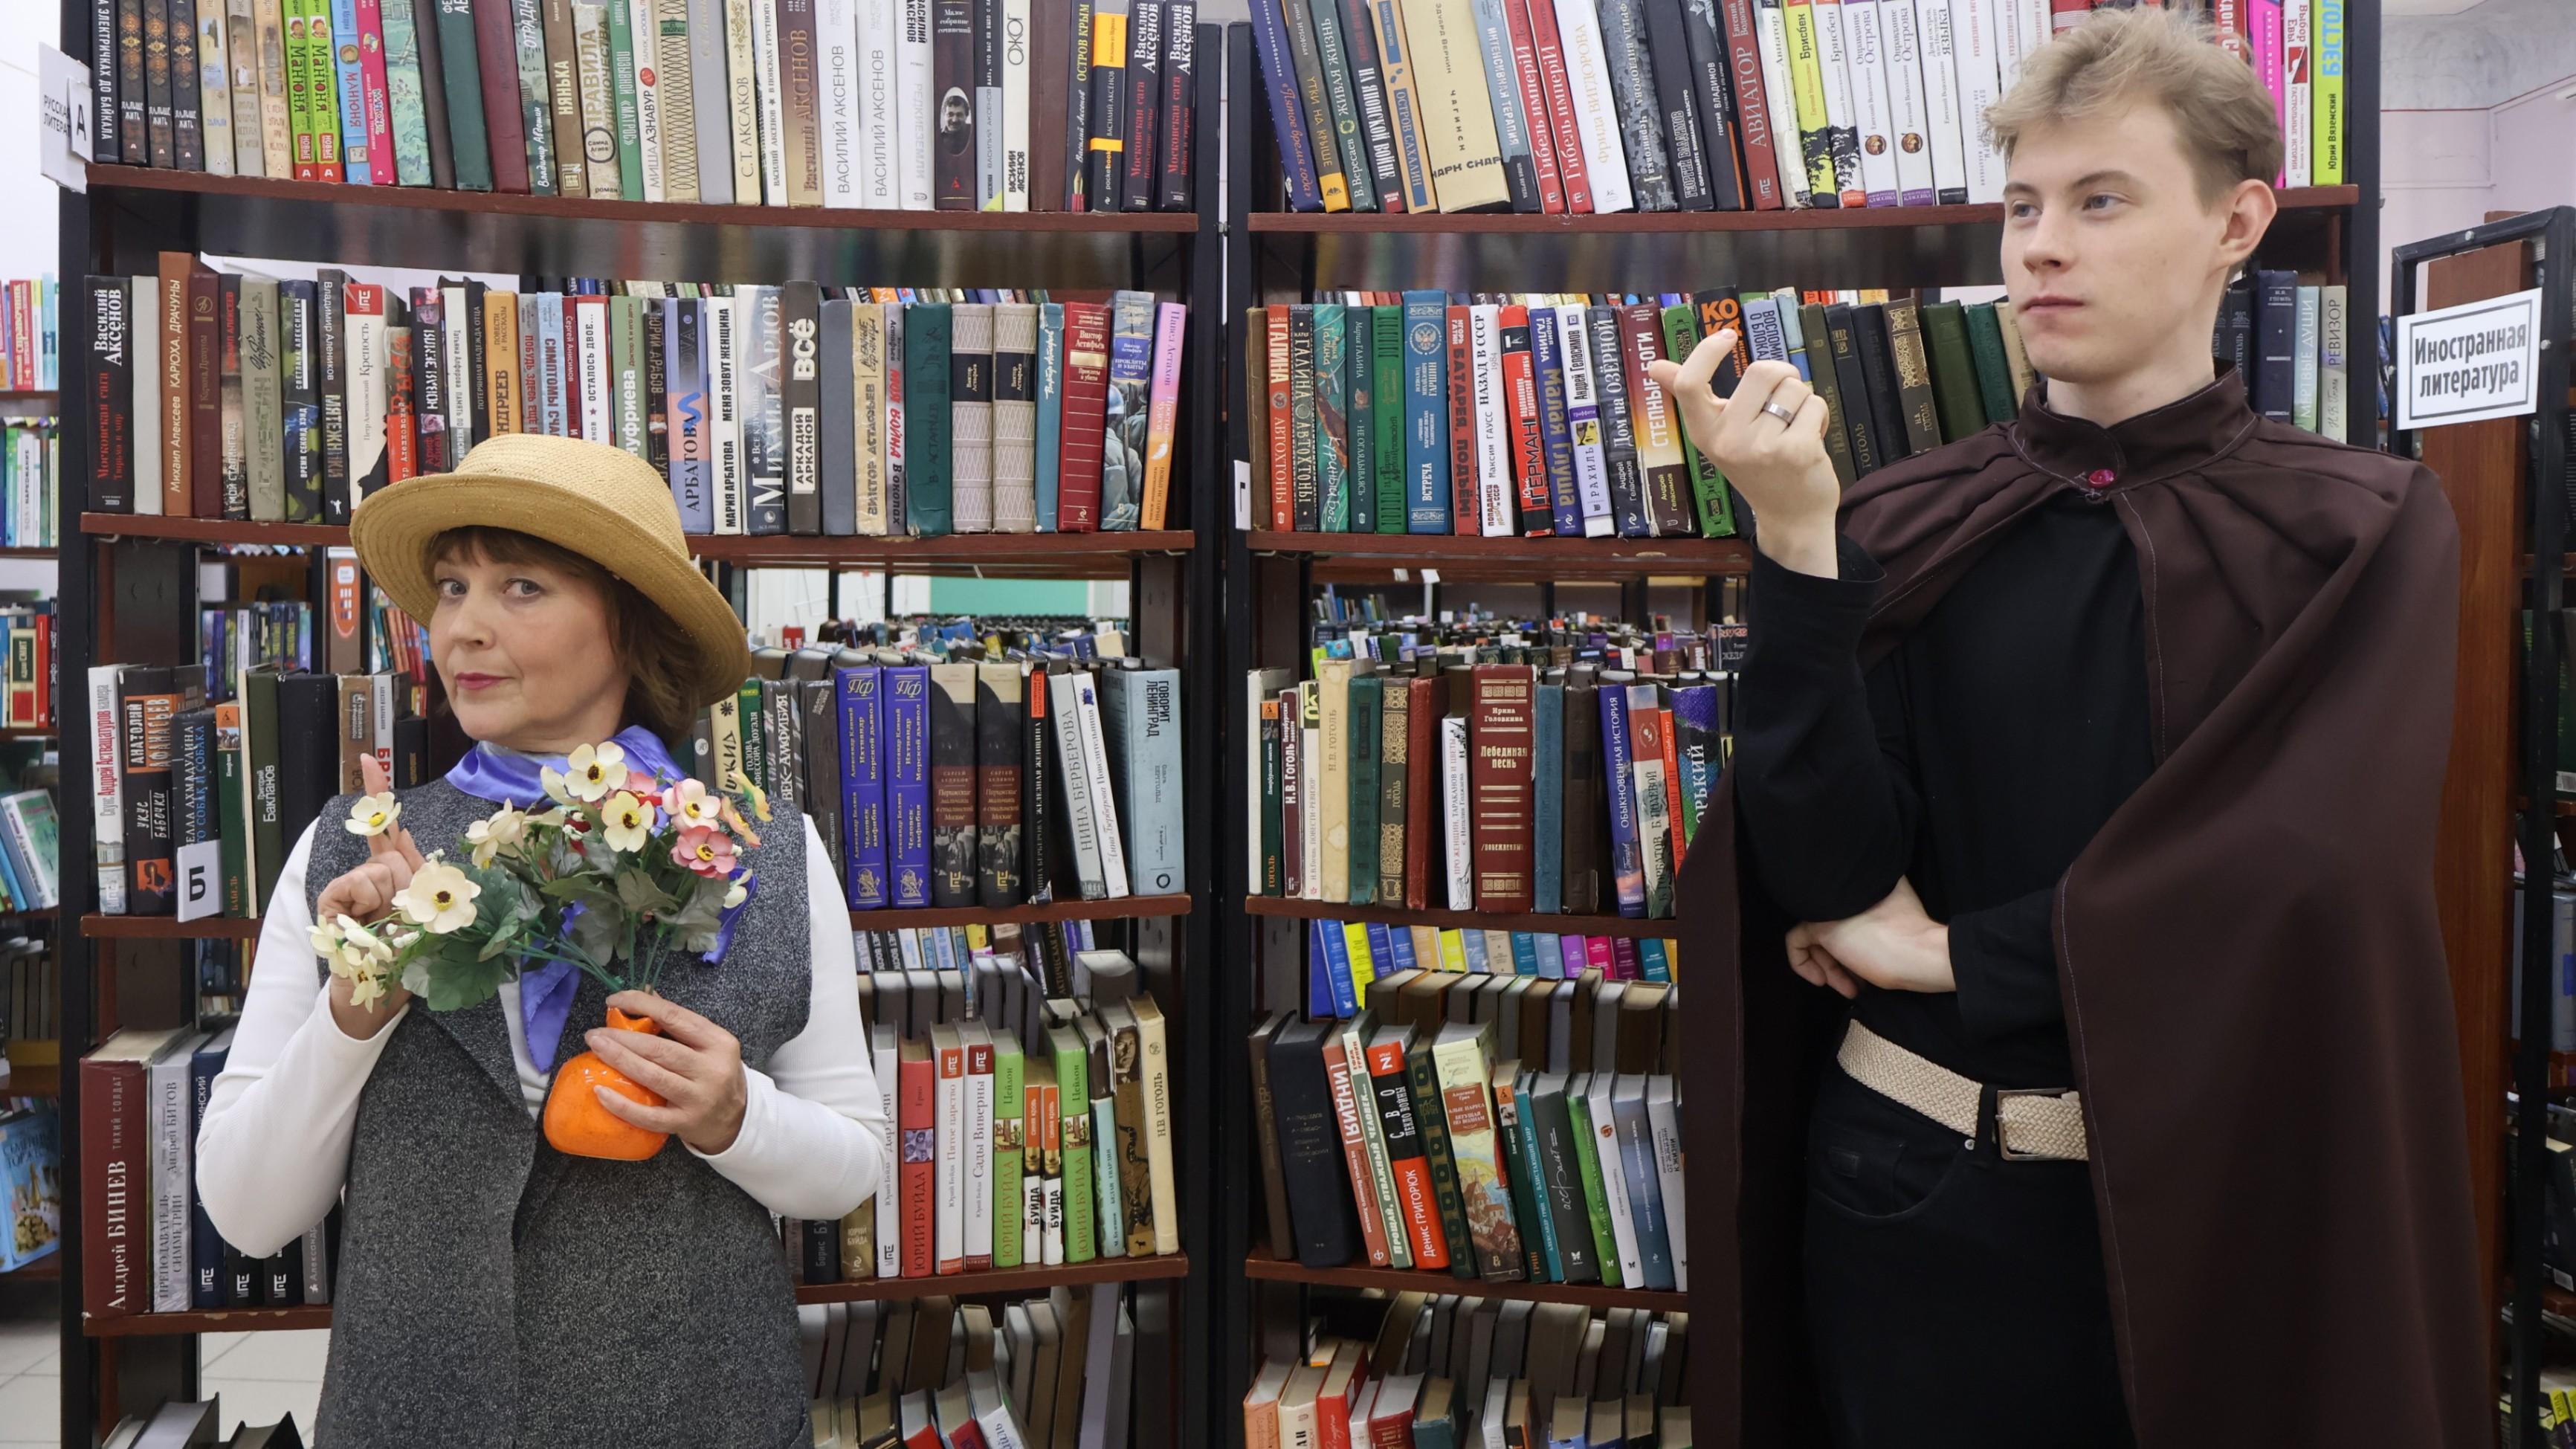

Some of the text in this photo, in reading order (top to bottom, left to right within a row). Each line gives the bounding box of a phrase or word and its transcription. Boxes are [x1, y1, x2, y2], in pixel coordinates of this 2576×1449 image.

[1007, 13, 1024, 65] ОЖОГ
[1134, 3, 1148, 59] Василий
[1142, 3, 1160, 74] Аксёнов
[1169, 4, 1184, 61] Василий
[1178, 5, 1194, 75] Аксёнов
[1798, 13, 1811, 59] Брисбен
[1827, 12, 1842, 62] Брисбен
[1862, 10, 1877, 64] Острова
[1900, 7, 1914, 62] Острова
[1938, 8, 1952, 55] языка
[2288, 19, 2297, 42] Евы
[2297, 4, 2308, 42] Выбор
[97, 9, 112, 140] ЭЛЕКТРИЧКАХ ДО БАЙКАЛА
[291, 45, 306, 113] Манюня
[312, 44, 328, 112] Манюня
[345, 71, 361, 127] МАНЮНЯ
[555, 60, 574, 115] НЯНЬКА
[616, 51, 636, 145] ПОЗЫВНОЙ «МАТРОС»
[1075, 4, 1089, 163] Василий Аксенов ОСТРОВ КРЫМ
[1320, 18, 1364, 198] В. Вересаев ЖИВАЯ ЖИЗНЬ
[1486, 27, 1520, 146] ИНТЕНСИВНАЯ ТЕРАПИЯ
[1707, 62, 1725, 136] ГЕОРГИЙ ВЛАДИМОВ
[1736, 47, 1768, 148] АВИАТОР
[77, 104, 87, 141] А
[643, 90, 661, 187] МИША АЗНАВУР
[790, 30, 817, 192] Василий АКСЕНОВ
[832, 46, 850, 193] ВАСИЛИЙ АКСЕНОВ
[871, 50, 887, 196] ВАСИЛИЙ АКСЕНОВ
[1307, 76, 1333, 167] УТКИ НА КРЫШЕ
[1358, 68, 1395, 180] НА ЯПОНСКОЙ ВОЙНЕ
[1395, 91, 1422, 186] ОСТРОВ САХАЛИН
[2328, 94, 2337, 170] Юрий Вяземский
[325, 135, 333, 159] НОВЫЕ
[533, 106, 549, 187] Владимир Авдошин
[1008, 151, 1016, 193] ВАСИЛИЙ
[1016, 152, 1025, 193] АКСЕНОВ
[1670, 110, 1698, 198] ГЕОРГИЙ ВЛАДИМОВ
[94, 287, 109, 352] Василий
[103, 288, 126, 367] Аксёнов
[294, 298, 302, 347] АЛЕКСИЕВИЧ
[324, 281, 335, 380] Владимир Алеников
[564, 315, 575, 382] Сергей Анисимов
[1270, 323, 1288, 384] ГАЛИНА
[1537, 317, 1549, 363] ГАЛИНА
[2328, 299, 2340, 366] РЕВИЗОР
[2414, 323, 2527, 365] Иностранная
[170, 280, 182, 493] Михаил Алексеев КАРЮХА. ДРАЧУНЫ
[474, 306, 485, 410] ПОТЕРЯННАЯ НАДЕЖДА ОТЦА
[543, 338, 558, 407] СИМПТОМЫ
[1294, 338, 1311, 407] ГАЛИНА
[1428, 361, 1438, 396] ГАРШИН
[1567, 330, 1588, 400] Андрей Геласимов
[1594, 318, 1633, 448] Дом на ОЗЁРНОЙ
[1636, 332, 1669, 448] СТЕПНЫЕ БОГИ
[2420, 358, 2519, 398] литература
[298, 408, 307, 425] ХЭНД
[719, 309, 736, 527] МАРИЯ АРБАТОВА МЕНЯ ЗОВУТ ЖЕНЩИНА
[793, 414, 804, 484] АРКАДИЙ
[804, 414, 813, 484] АРКАНОВ
[865, 383, 877, 515] ВИКТОР АСТАФЬЕВ
[1543, 368, 1575, 506] Малая Глуша
[683, 416, 700, 511] АРБАТОВА
[1273, 416, 1287, 504] АВТОХТОНЫ
[1297, 422, 1311, 503] АВТОХТОНЫ
[1421, 462, 1433, 501] ВСТРЕЧА
[1586, 447, 1600, 497] РАХИЛЬ
[1667, 473, 1677, 511] Геласимов
[128, 703, 145, 764] АНАТОЛИЙ
[146, 698, 172, 767] АФАНАСЬЕВ
[1146, 680, 1160, 737] ЛЕНИНГРАД
[1159, 680, 1169, 723] ГОВОРИТ
[1483, 714, 1524, 723] Головкина
[1033, 722, 1042, 814] ЖЕЛЕЗНАЯ ЖЕНЩИНА
[1062, 709, 1094, 851] НИНА БЕРБЕРОВА
[1480, 745, 1529, 760] Лебединая
[1491, 758, 1517, 770] песнь
[1610, 697, 1630, 828] ОБЫКНОВЕННАЯ ИСТОРИЯ
[137, 801, 149, 828] УКУС
[153, 793, 167, 839] БАБОЧКИ
[263, 765, 276, 822] Бакланов
[1392, 780, 1401, 808] ГОГОЛЬ
[167, 1081, 178, 1175] Андрей БИТОВ
[1153, 1073, 1165, 1115] ГОГОЛЬ
[1394, 1086, 1416, 1136] ПЕКЛО ВОЙНЫ
[972, 1080, 986, 1178] Сады Виверны
[107, 1075, 128, 1311] Андрей БИНЕВ ТИХИЙ СОЛДАТ
[911, 1171, 927, 1271] ЮРИЙ БУЙДА
[1029, 1187, 1041, 1225] БУЙДА
[1048, 1190, 1060, 1228] БУЙДА
[1405, 1169, 1437, 1257] Денис ГРИГОРЮК
